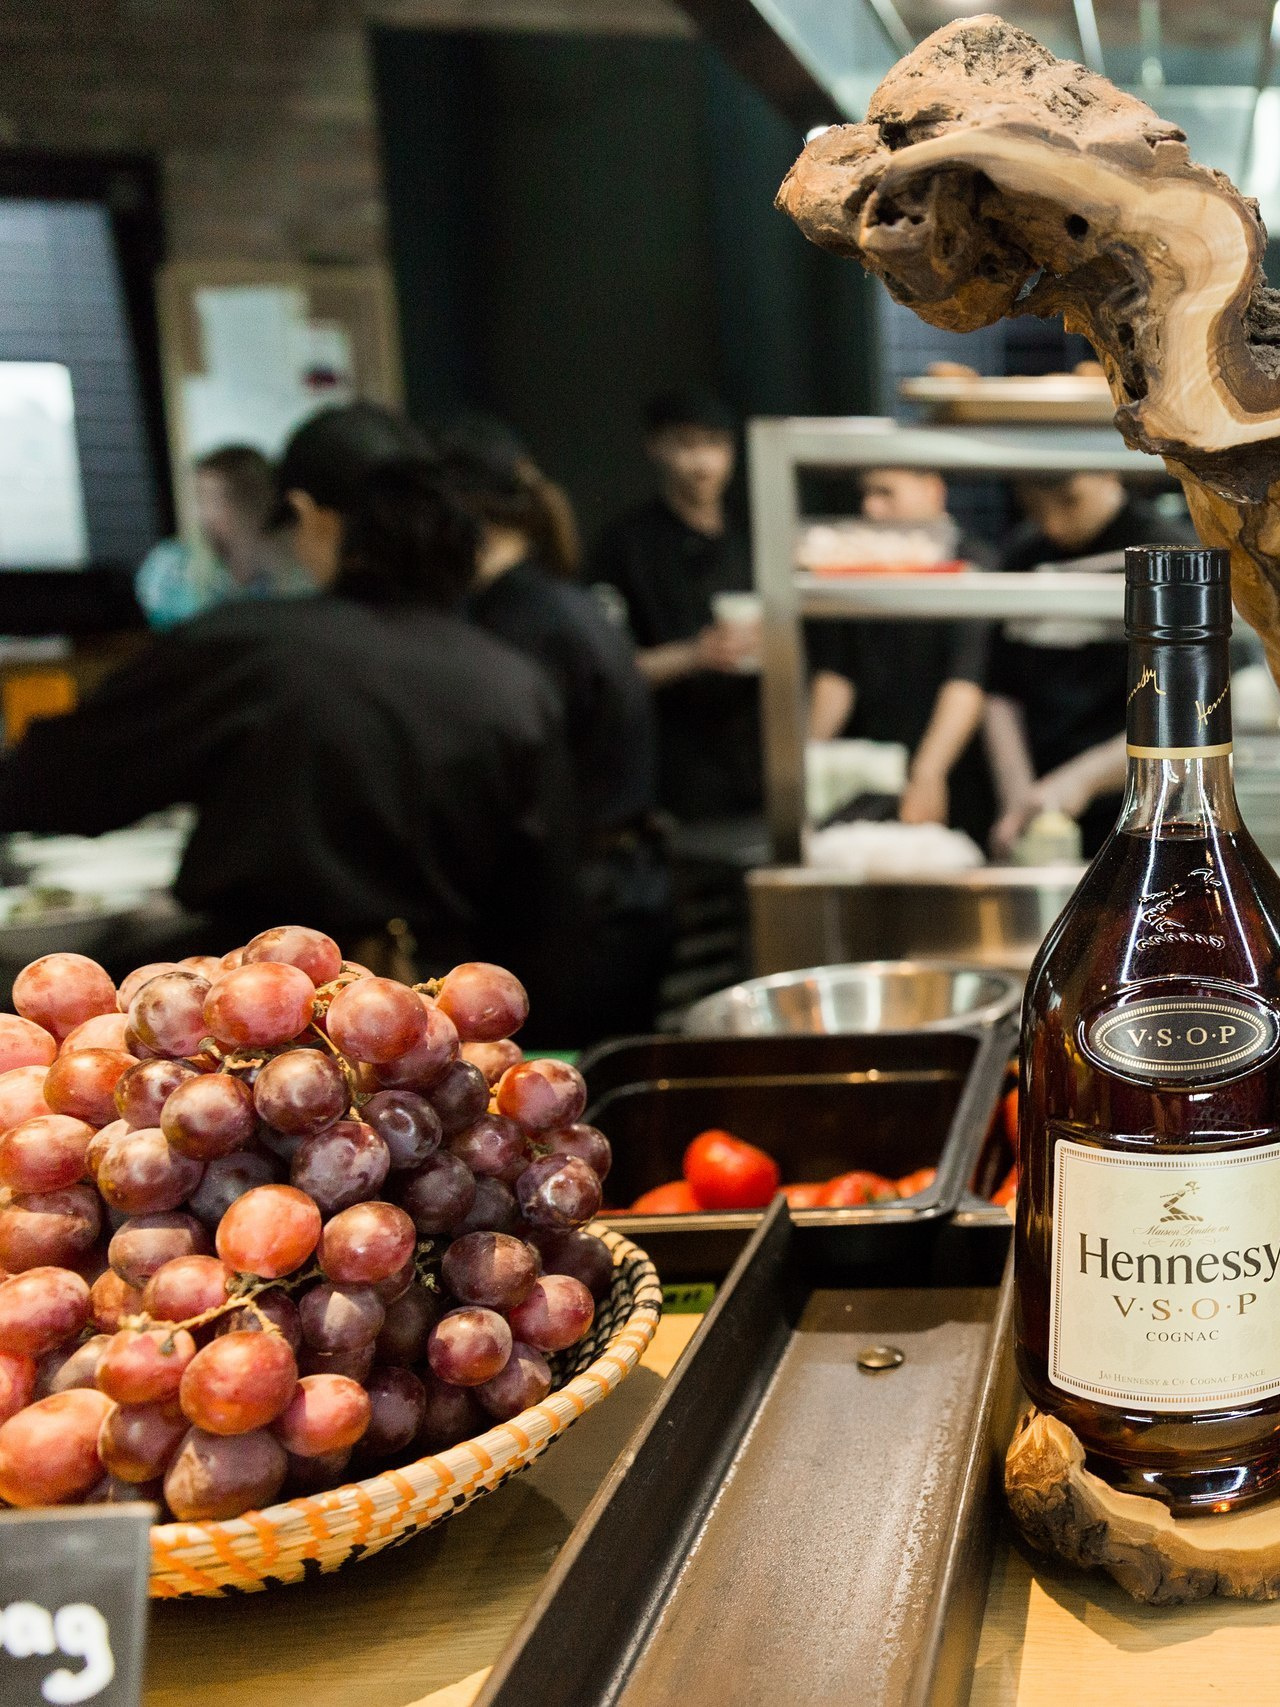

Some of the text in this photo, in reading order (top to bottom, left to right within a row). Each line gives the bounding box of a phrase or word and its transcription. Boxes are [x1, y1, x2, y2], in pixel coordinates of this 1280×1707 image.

[1133, 1224, 1180, 1236] Maison
[1169, 1238, 1192, 1248] 1765
[1145, 1329, 1220, 1343] COGNAC
[0, 1601, 116, 1704] ag
